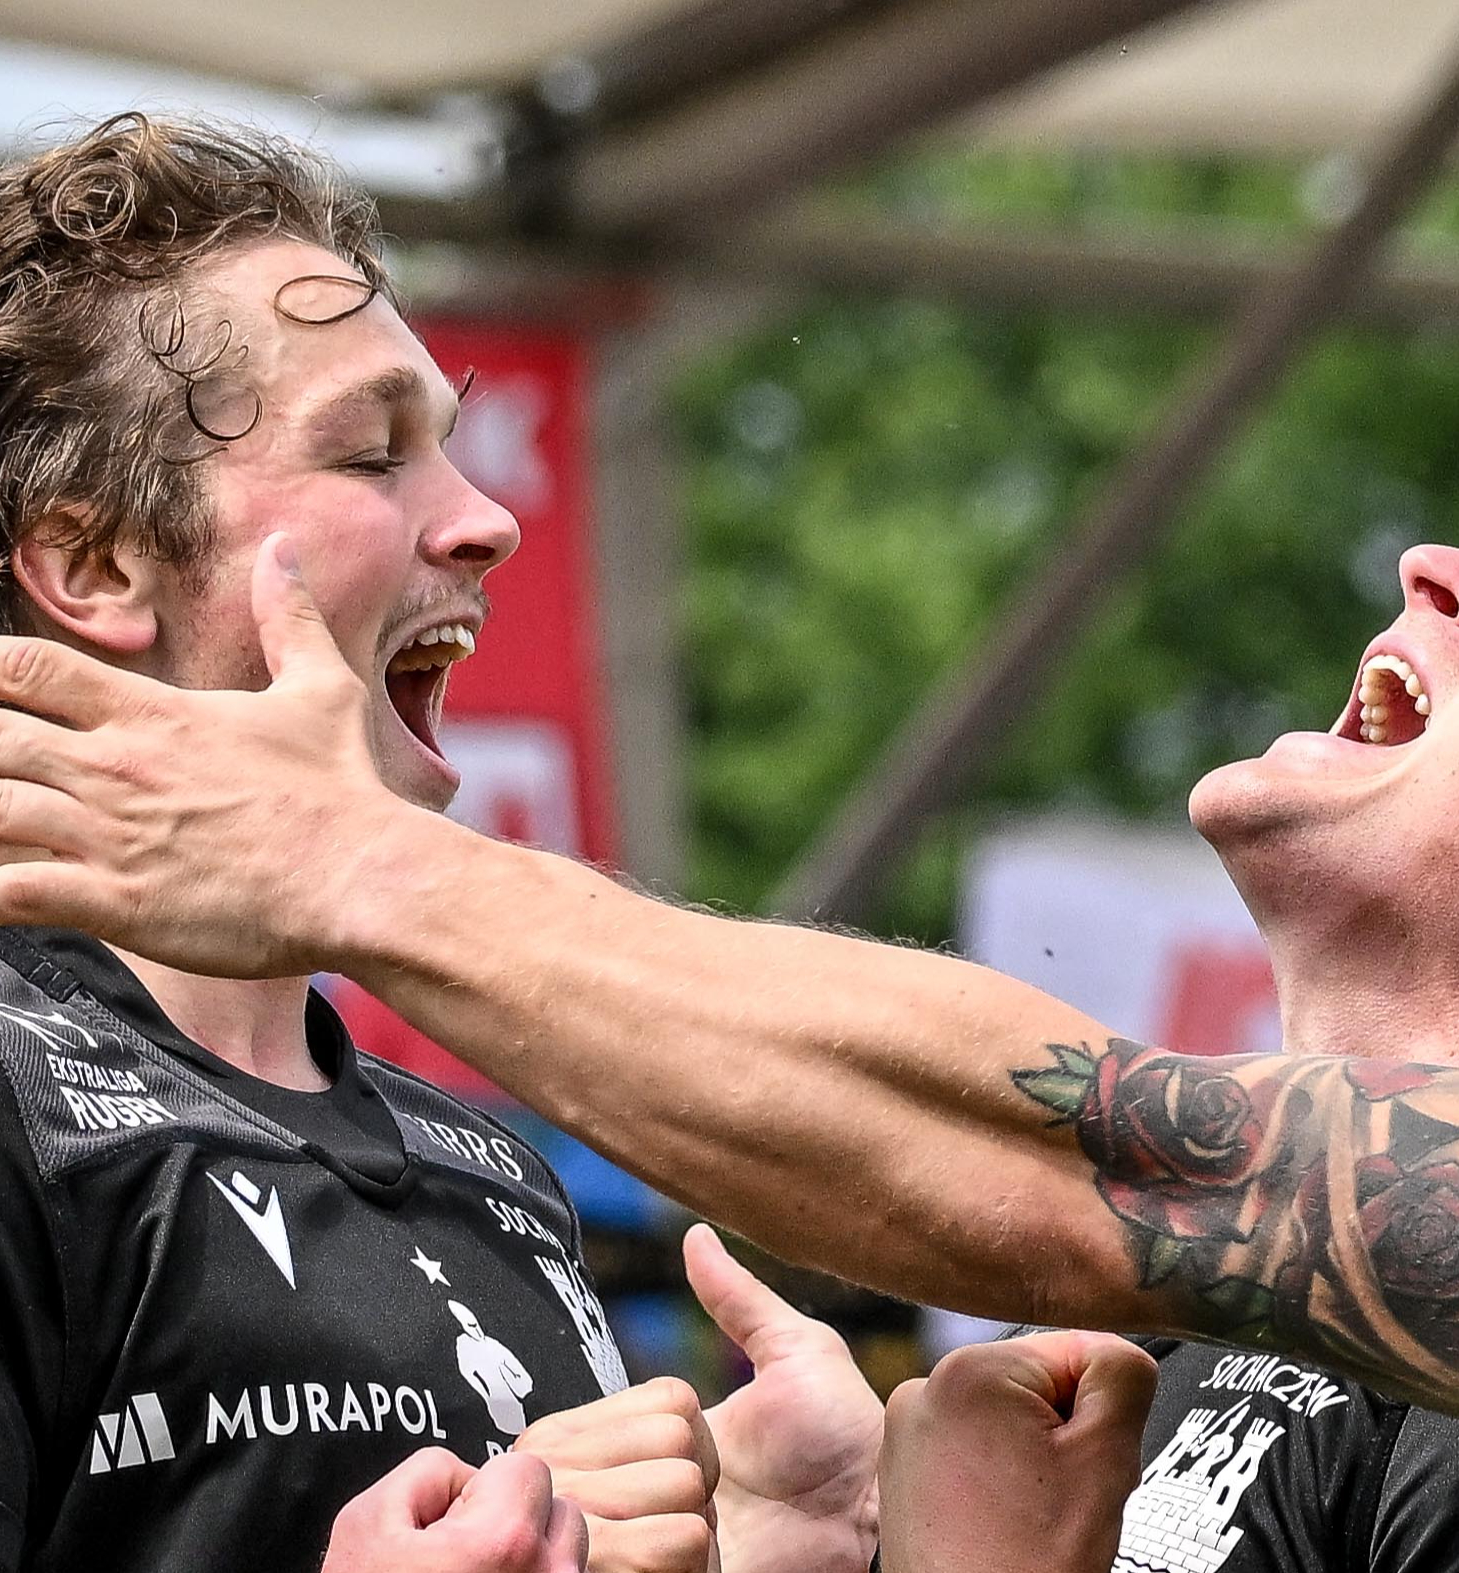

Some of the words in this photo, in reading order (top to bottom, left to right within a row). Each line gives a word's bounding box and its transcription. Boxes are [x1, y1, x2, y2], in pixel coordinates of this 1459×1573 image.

[46, 1052, 148, 1093] EKSTRALIGA
[59, 1085, 179, 1131] RUGBY
[205, 1381, 448, 1445] MURAPOL
[1198, 1354, 1350, 1418] SOCHACZEW
